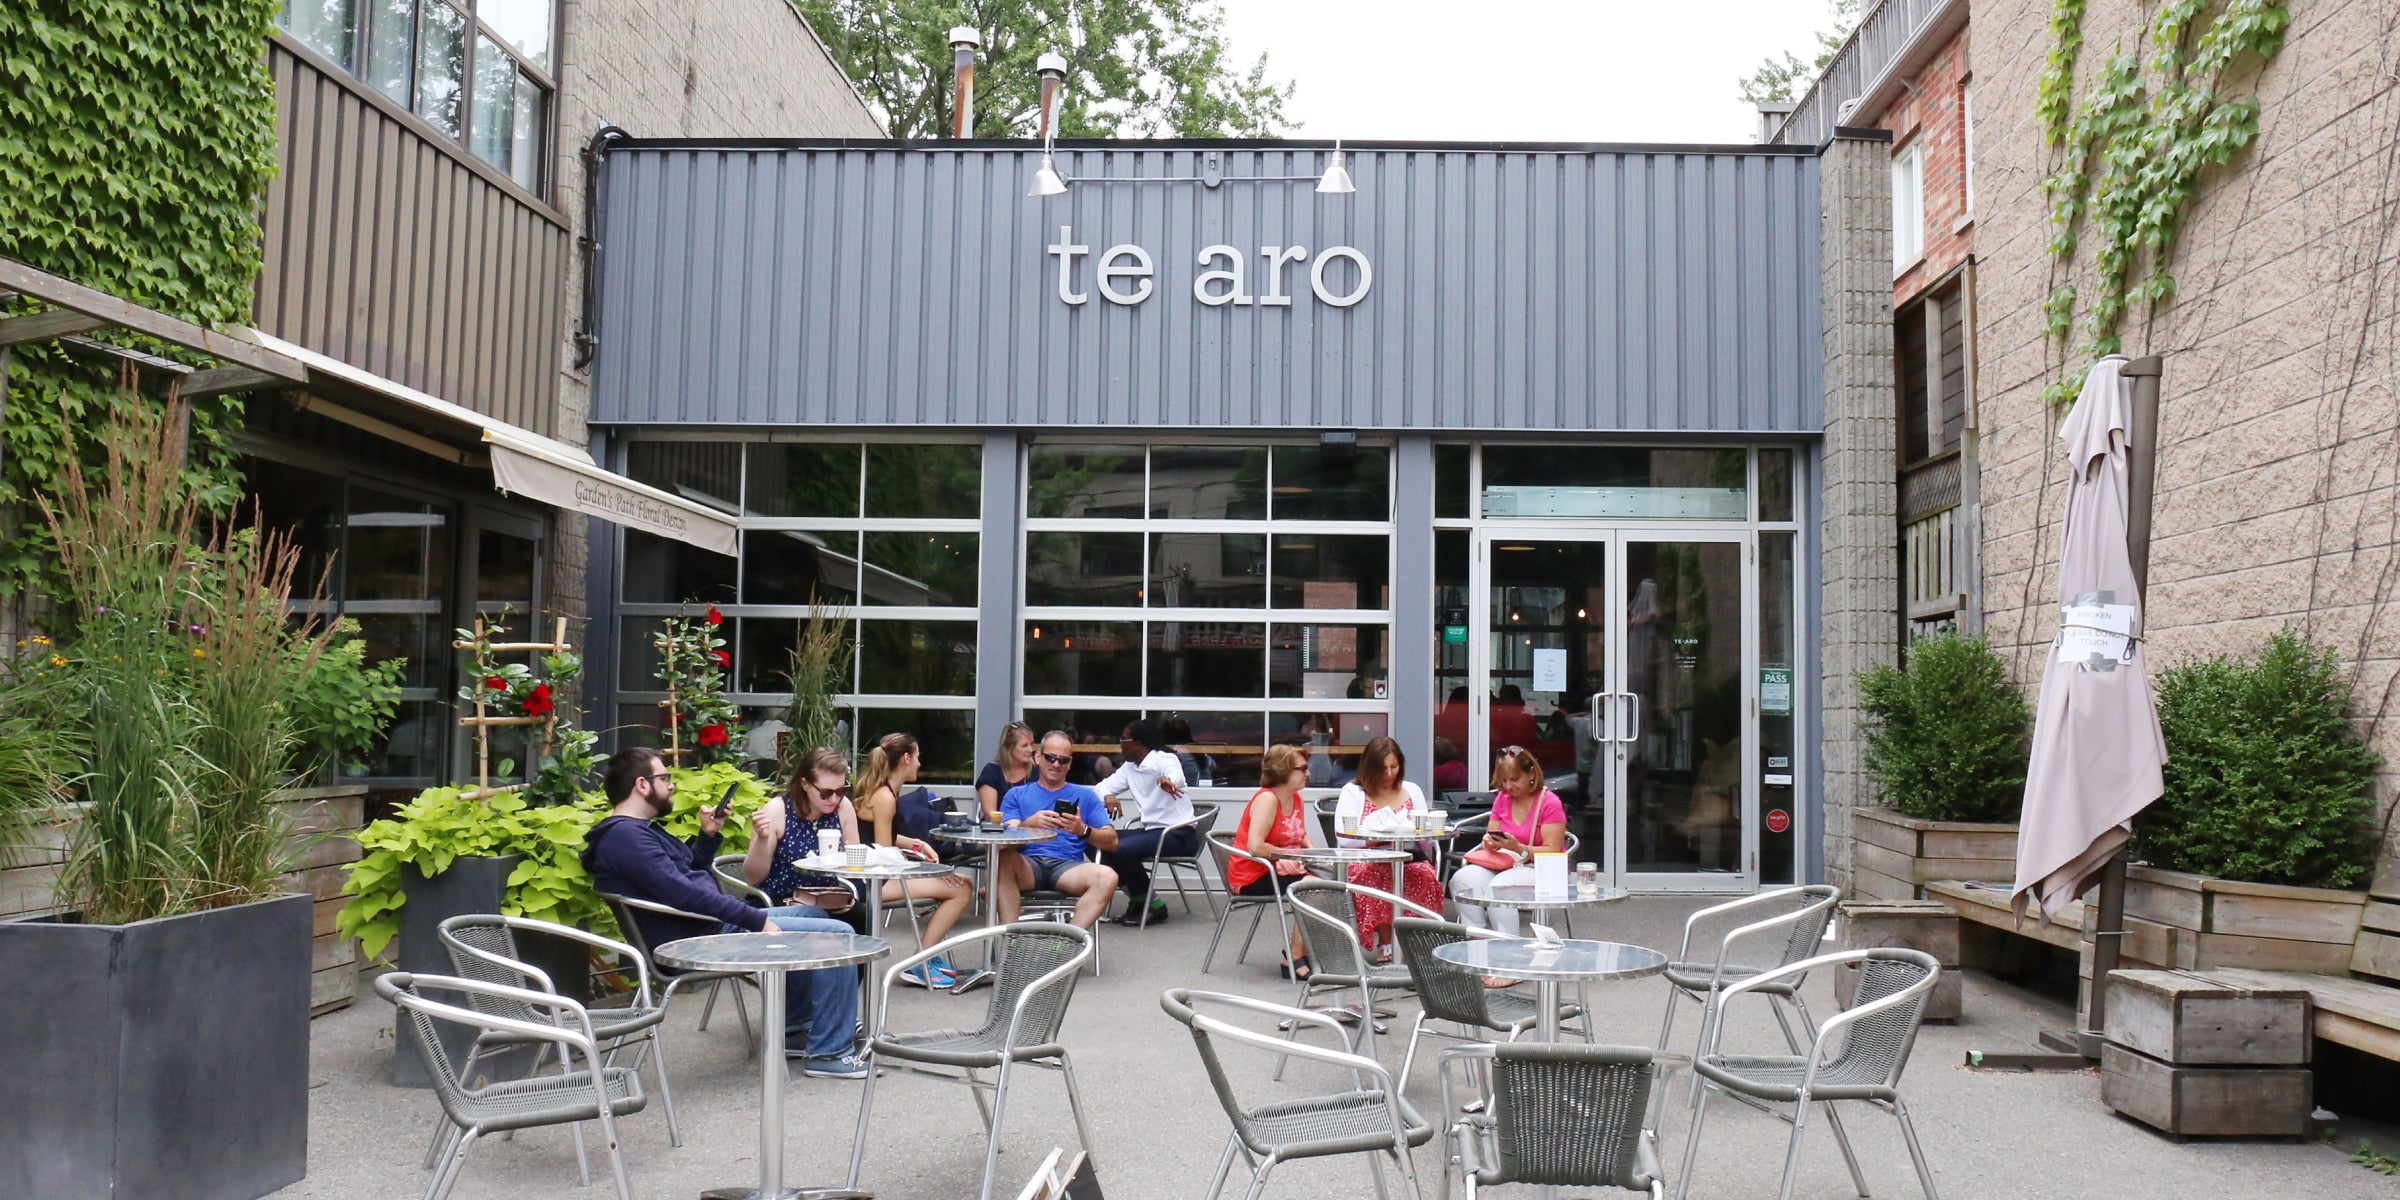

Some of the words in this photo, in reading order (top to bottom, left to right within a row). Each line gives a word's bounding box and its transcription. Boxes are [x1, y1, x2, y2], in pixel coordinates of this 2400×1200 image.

[1048, 225, 1154, 305] te
[1193, 244, 1373, 307] aro
[575, 480, 613, 509] Garden's
[615, 493, 636, 516] Path
[636, 500, 662, 524] Floral
[662, 509, 688, 537] Design
[1764, 674, 1787, 683] PASS
